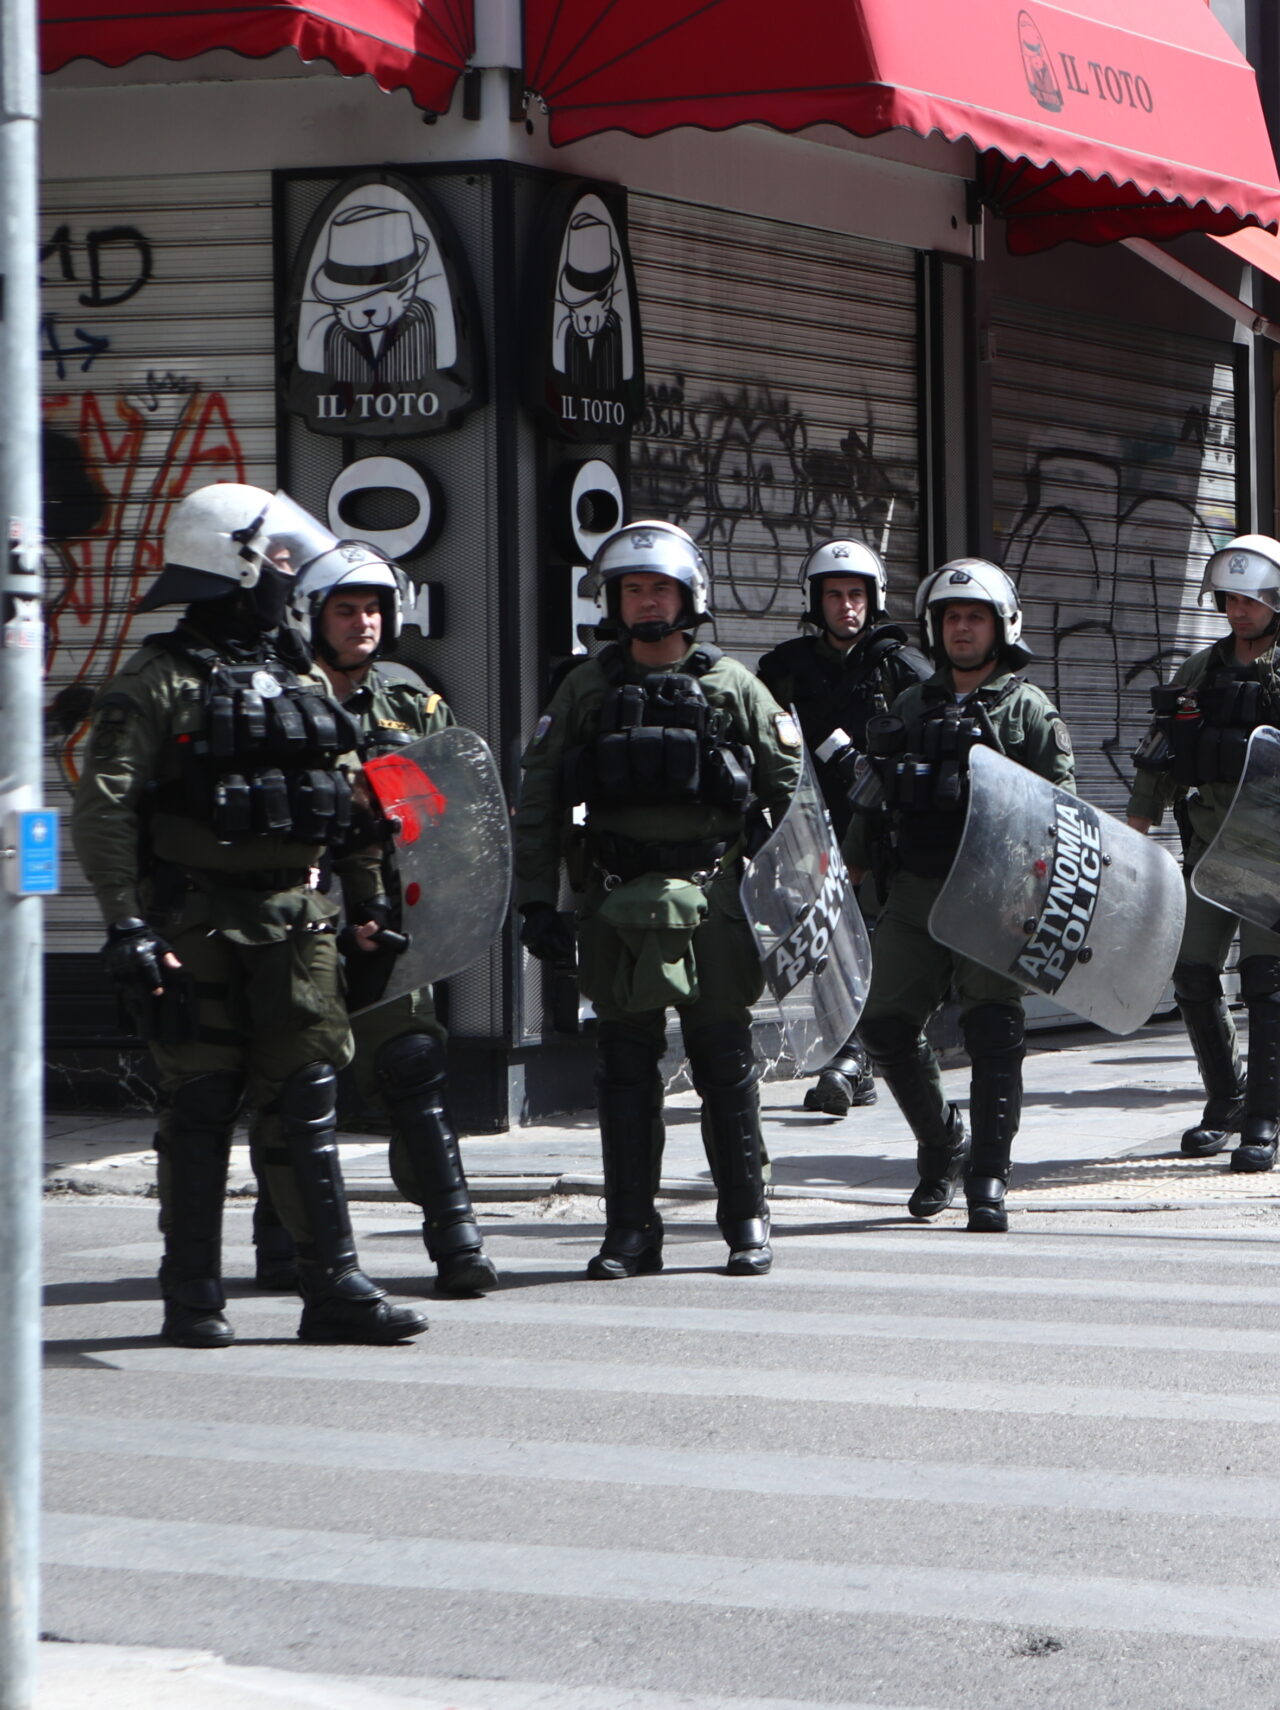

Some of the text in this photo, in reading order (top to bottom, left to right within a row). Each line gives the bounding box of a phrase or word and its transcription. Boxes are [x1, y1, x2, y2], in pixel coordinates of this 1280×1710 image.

[1058, 52, 1153, 113] IL TOTO
[317, 391, 439, 418] IL TOTO
[562, 395, 625, 425] IL TOTO
[1017, 803, 1082, 979] ΑΣΤΥΝΟΜΙΑ
[1044, 819, 1100, 981] POLICE
